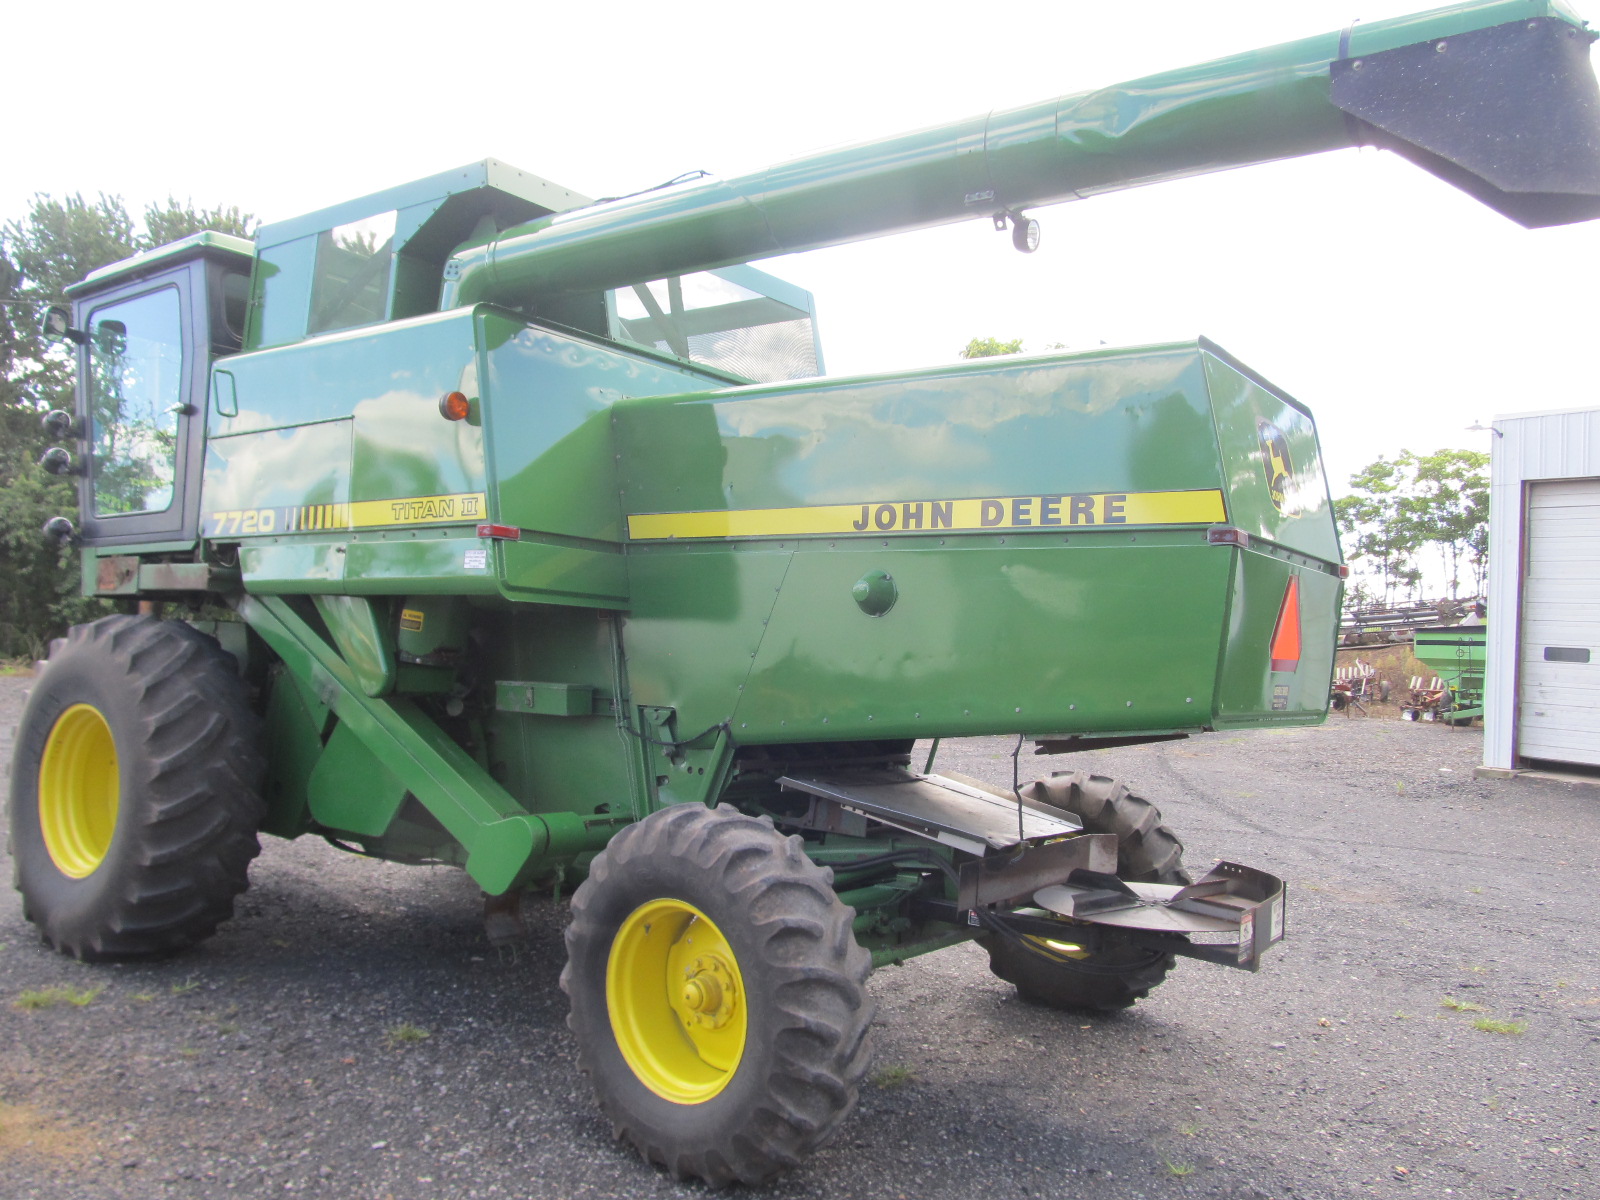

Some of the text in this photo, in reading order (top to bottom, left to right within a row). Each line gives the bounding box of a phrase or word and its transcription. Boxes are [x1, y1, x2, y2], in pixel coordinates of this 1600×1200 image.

[212, 496, 478, 535] 7720 TITAN II
[852, 495, 1127, 531] JOHN DEERE
